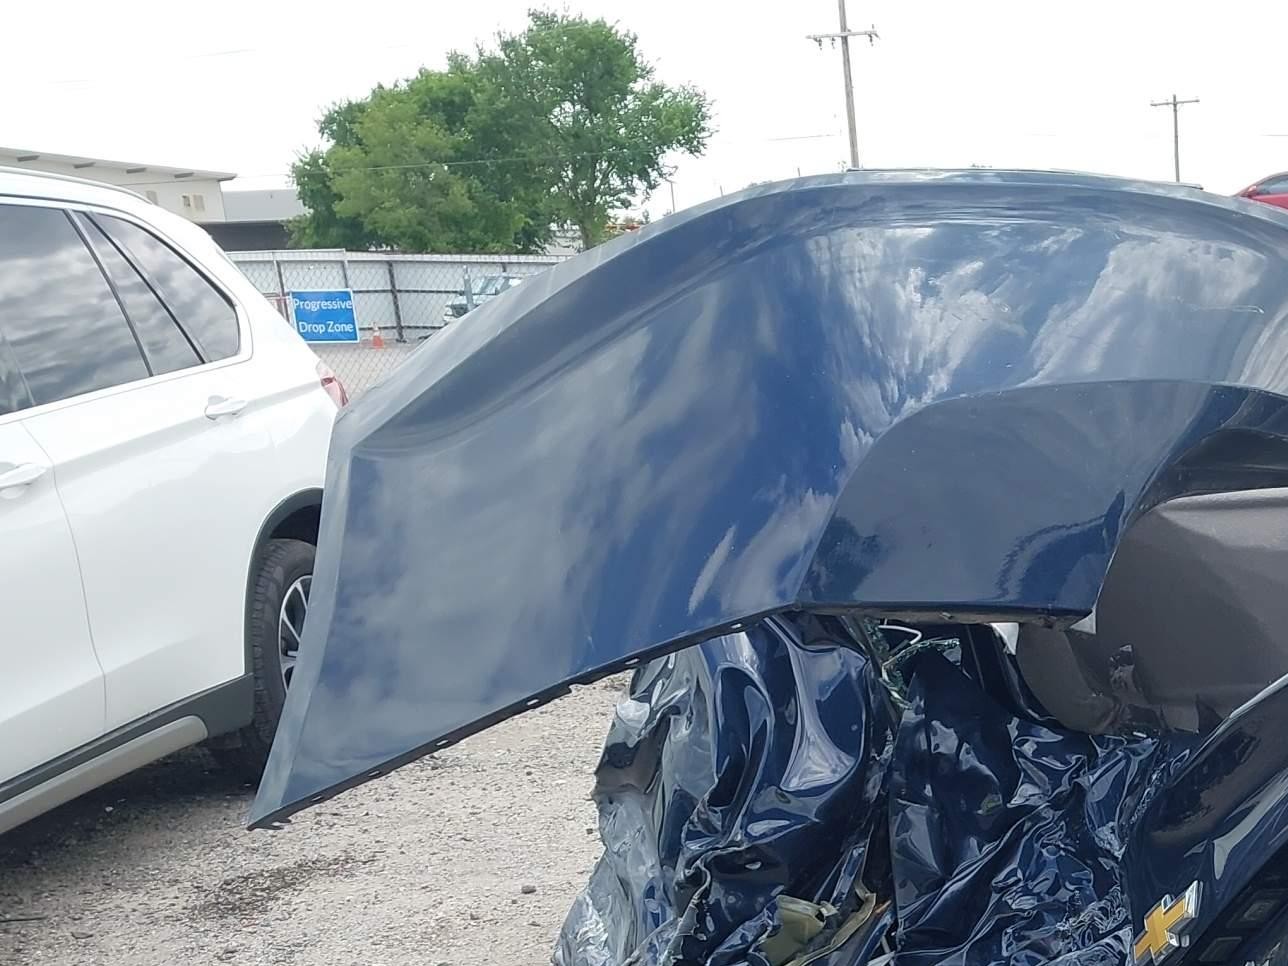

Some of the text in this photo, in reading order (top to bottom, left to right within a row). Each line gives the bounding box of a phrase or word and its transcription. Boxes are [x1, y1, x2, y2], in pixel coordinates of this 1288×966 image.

[294, 299, 353, 311] Progressive
[298, 321, 354, 333] Drop Zone
